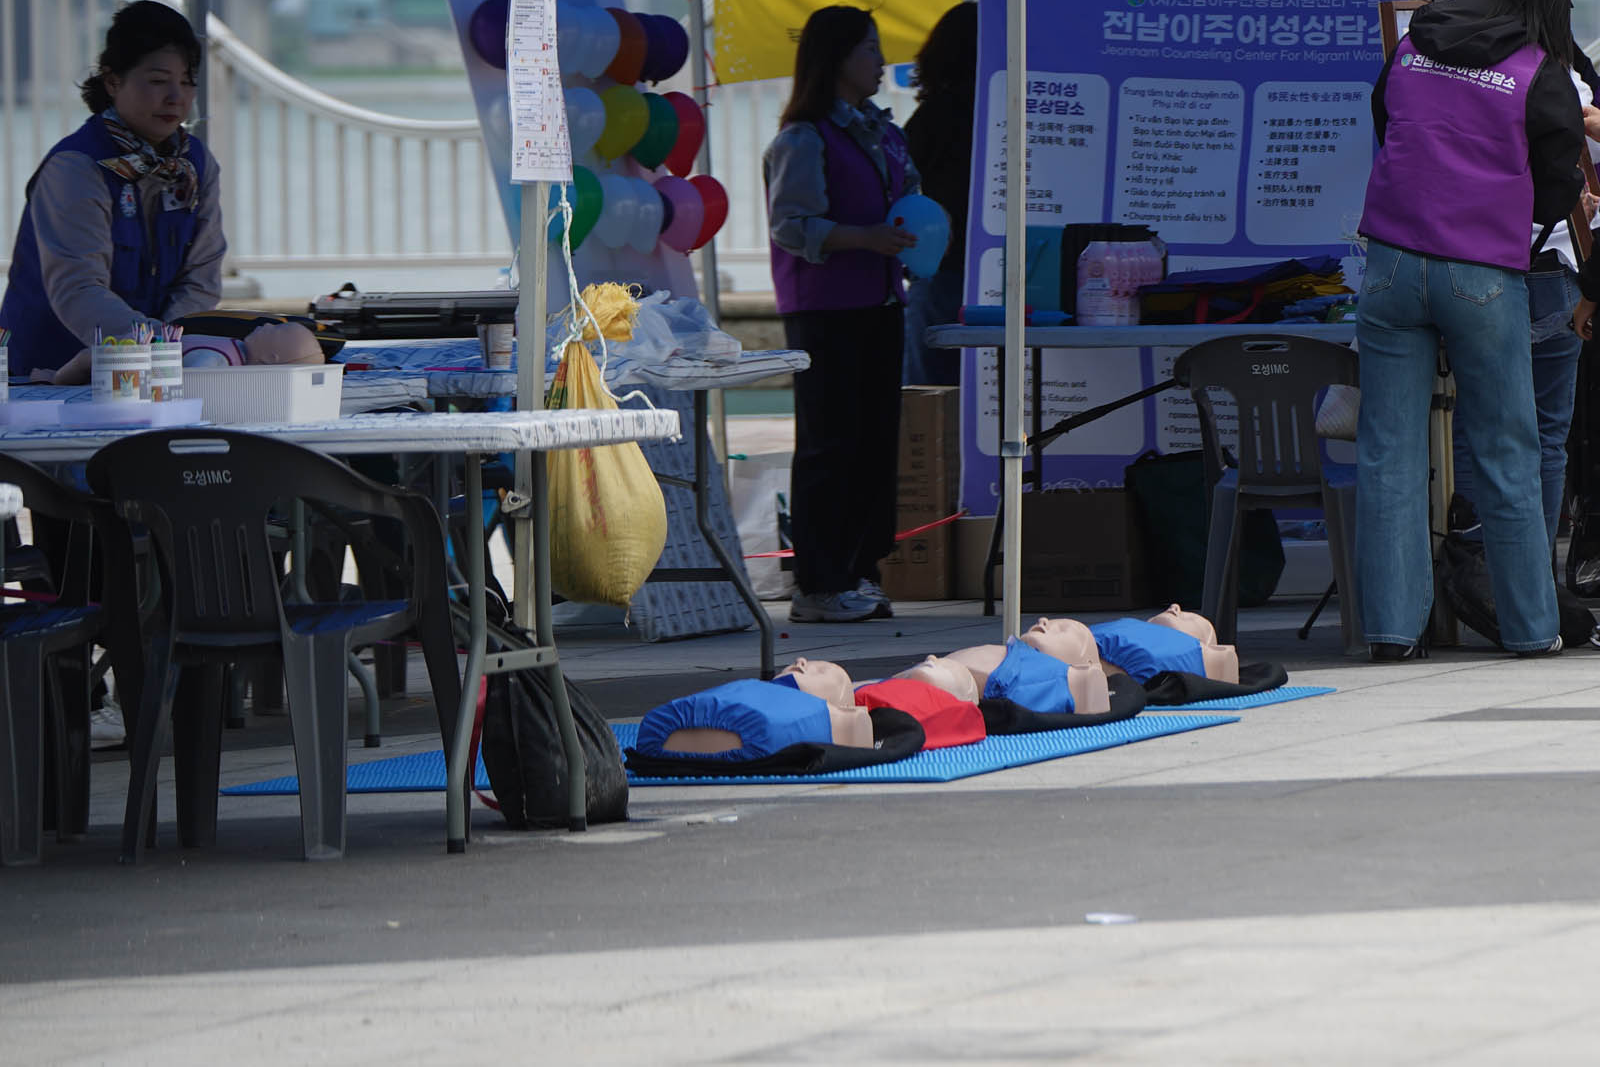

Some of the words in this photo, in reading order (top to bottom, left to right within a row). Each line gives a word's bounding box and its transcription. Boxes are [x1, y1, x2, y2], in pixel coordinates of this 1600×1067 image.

[1161, 46, 1232, 63] Counseling
[1234, 49, 1277, 61] Center
[1280, 49, 1300, 61] For
[1303, 50, 1350, 64] Migrant
[1351, 50, 1384, 62] Wom
[1026, 99, 1085, 116] 문상담소
[1252, 364, 1290, 375] 오성IMC
[182, 469, 232, 486] 오성IMC
